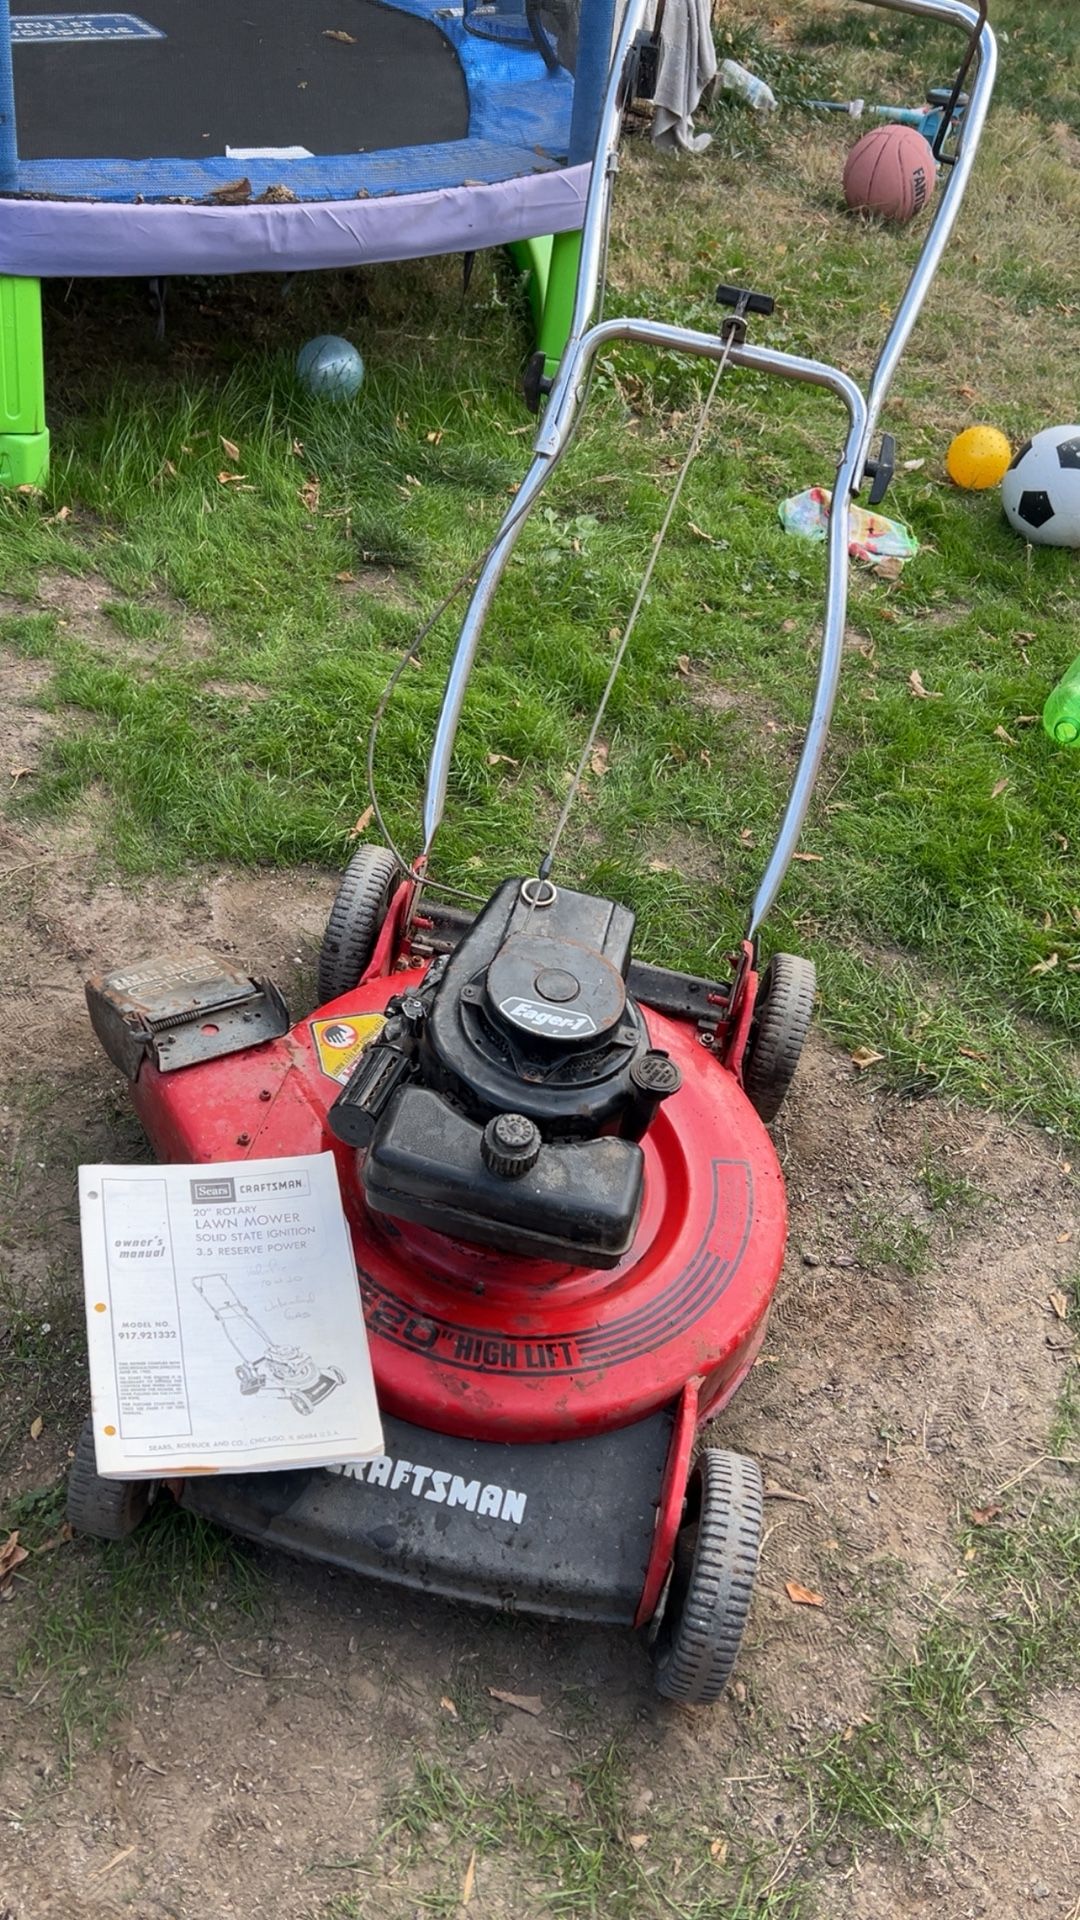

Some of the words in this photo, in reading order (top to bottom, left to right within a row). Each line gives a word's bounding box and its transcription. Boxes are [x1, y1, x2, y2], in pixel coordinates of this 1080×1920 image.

[510, 1003, 587, 1030] Eager-1
[199, 1183, 229, 1196] Sears
[240, 1180, 302, 1194] CRAFTSMAN
[216, 1206, 257, 1216] ROTARY
[195, 1218, 238, 1230] LAWN
[244, 1213, 301, 1227] MOWER
[114, 1235, 164, 1247] owner's
[195, 1233, 227, 1242] SOLID
[231, 1231, 263, 1241] STATE
[266, 1226, 316, 1239] IGNITION
[119, 1246, 166, 1258] manual
[195, 1247, 213, 1256] 3.5
[218, 1245, 264, 1256] RESERVE
[267, 1241, 308, 1252] POWER
[118, 1331, 177, 1340] 917.921332
[454, 1336, 517, 1368] HIGH
[525, 1342, 574, 1369] LIFT
[325, 1456, 527, 1524] RAFTSMAN
